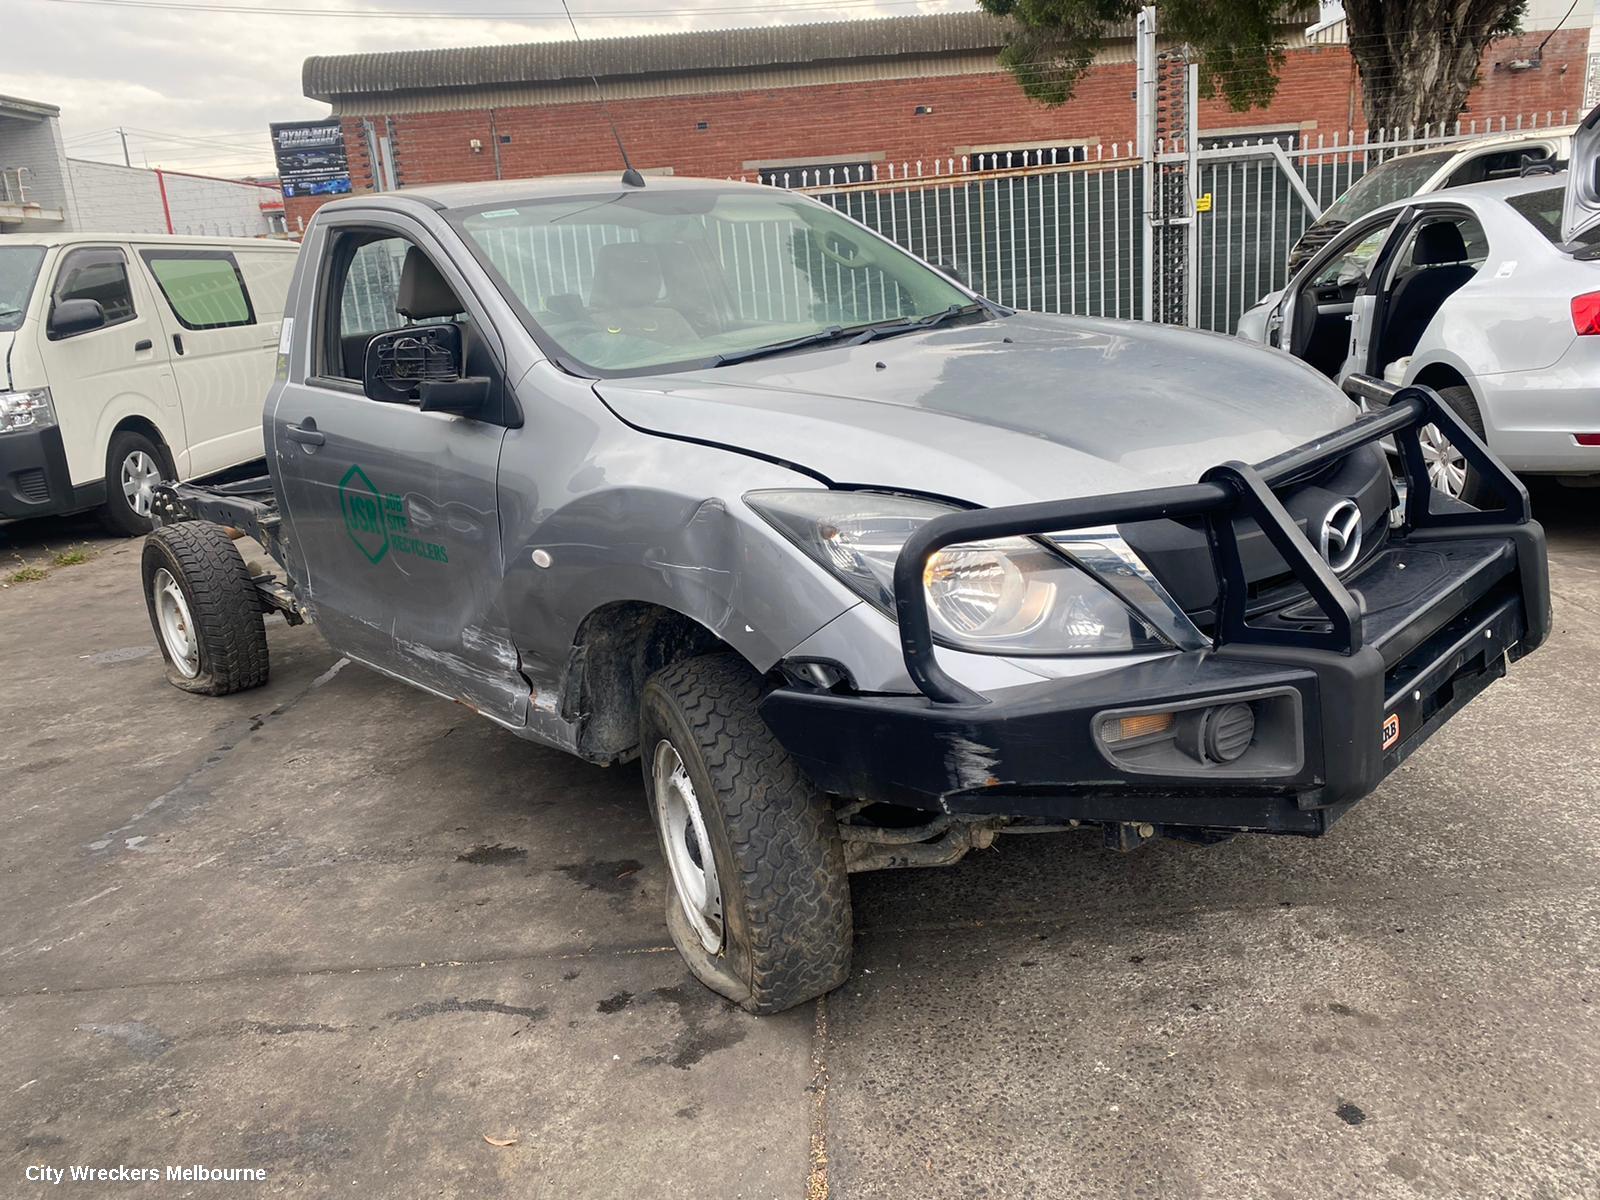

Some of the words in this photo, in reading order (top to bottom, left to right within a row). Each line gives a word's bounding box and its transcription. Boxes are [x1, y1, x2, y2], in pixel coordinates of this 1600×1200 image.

[280, 127, 339, 142] DYNO-MITE
[385, 493, 402, 512] JOB
[350, 494, 380, 535] JSR
[386, 513, 408, 532] SITE
[390, 534, 449, 564] RECYCLERS
[1383, 721, 1396, 742] RB
